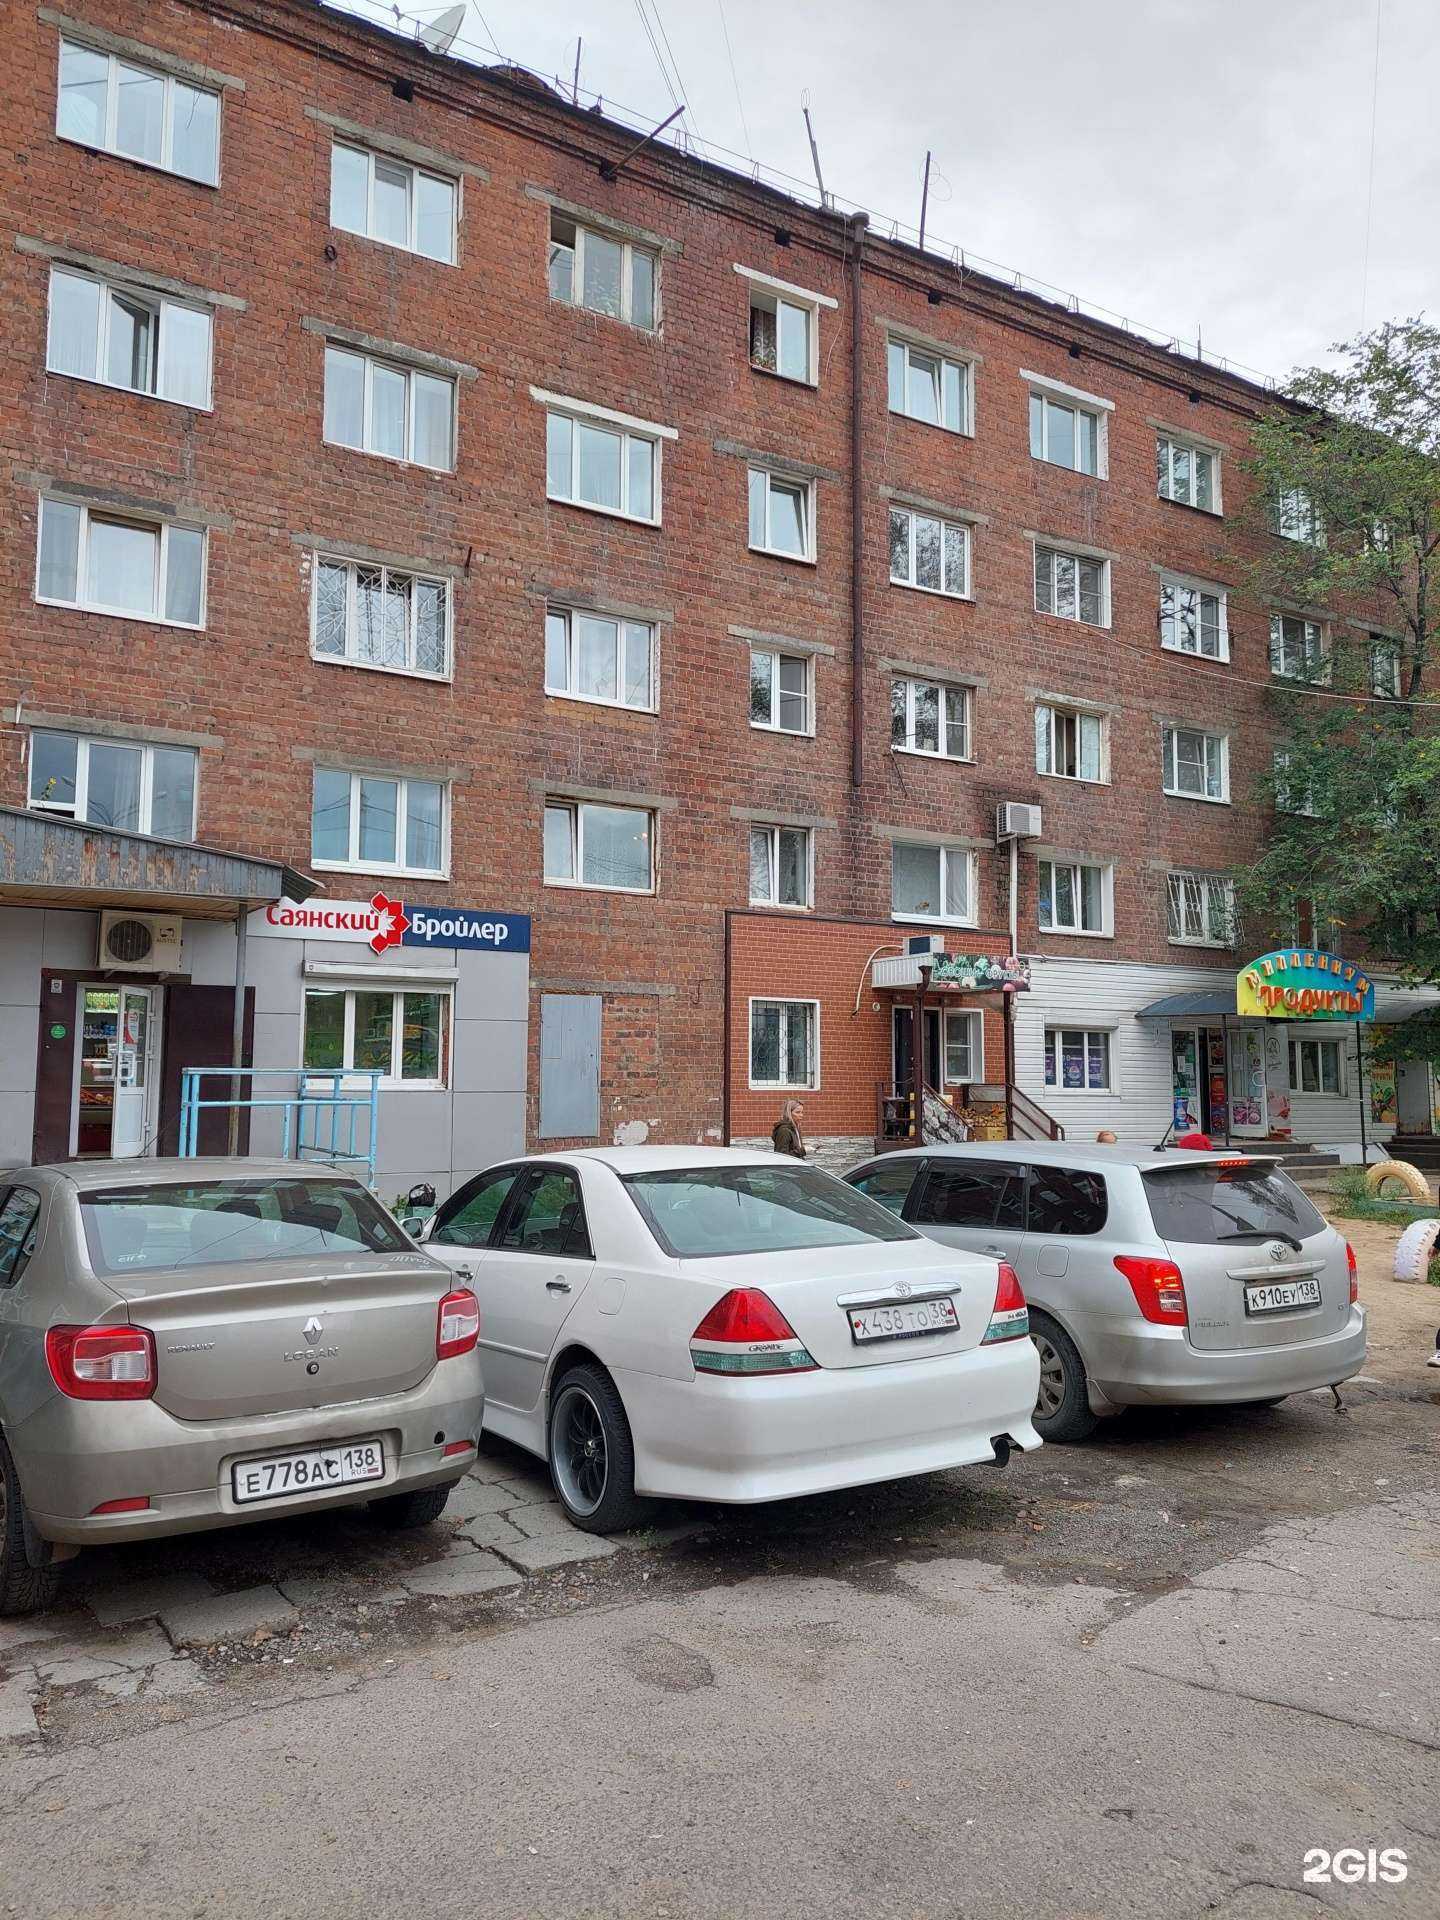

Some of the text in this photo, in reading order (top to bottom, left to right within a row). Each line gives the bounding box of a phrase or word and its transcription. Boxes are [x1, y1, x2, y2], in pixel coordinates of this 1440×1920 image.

[266, 904, 509, 944] Саянский Бройлер
[1257, 985, 1364, 1017] ПРОДУКТЫ
[1298, 1282, 1315, 1296] 138
[929, 1302, 947, 1319] 38
[167, 1342, 216, 1354] RENAULT
[284, 1346, 339, 1361] LOGAN
[748, 1343, 785, 1353] GRANDE
[344, 1447, 376, 1469] 138
[352, 1468, 368, 1477] RUS
